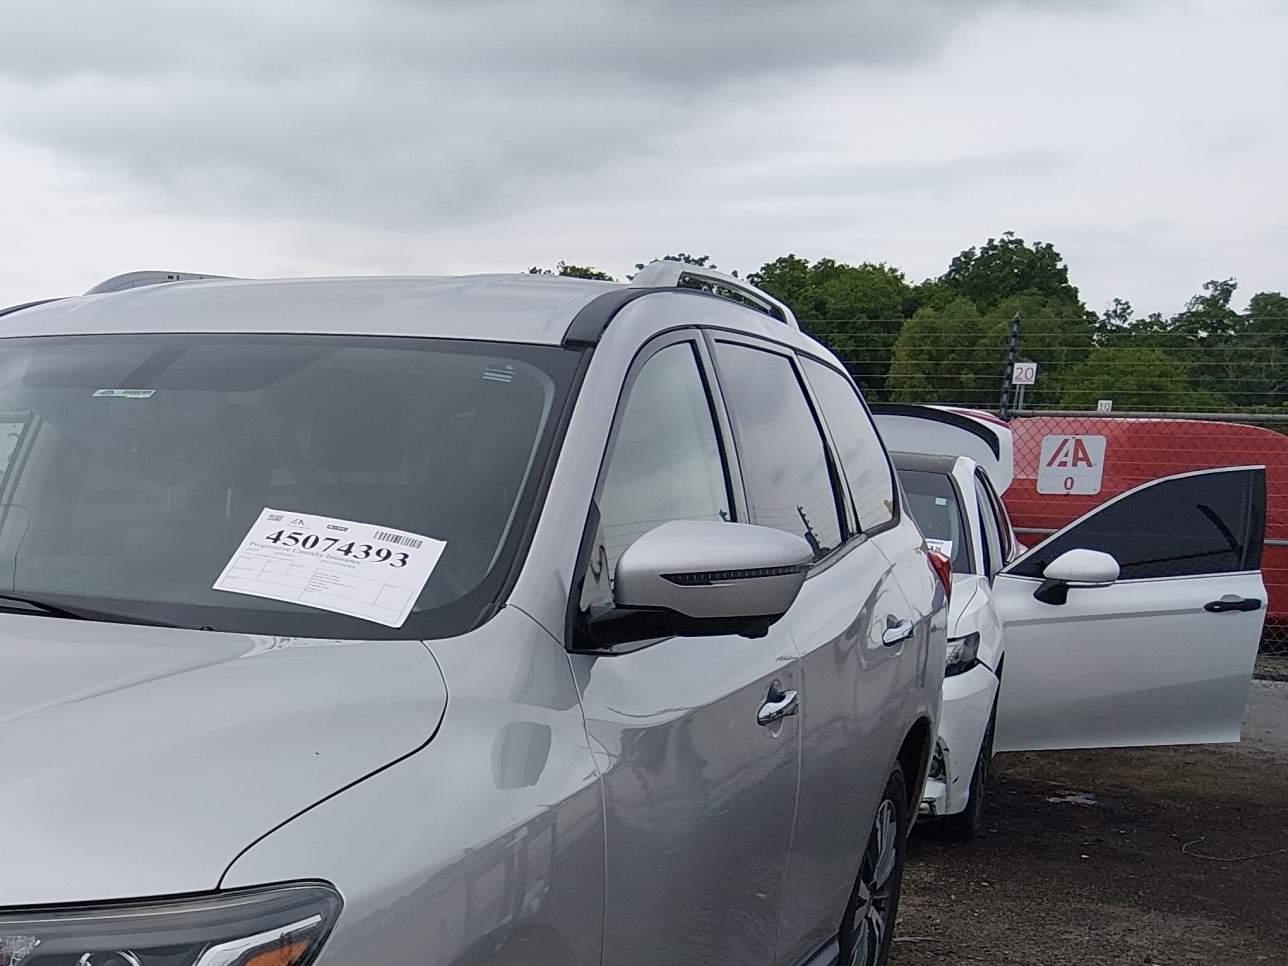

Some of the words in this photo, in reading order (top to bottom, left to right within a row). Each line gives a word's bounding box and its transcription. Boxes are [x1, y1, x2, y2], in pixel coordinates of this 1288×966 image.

[1014, 367, 1035, 381] 20
[1063, 476, 1075, 491] 0
[265, 529, 410, 568] 45074393
